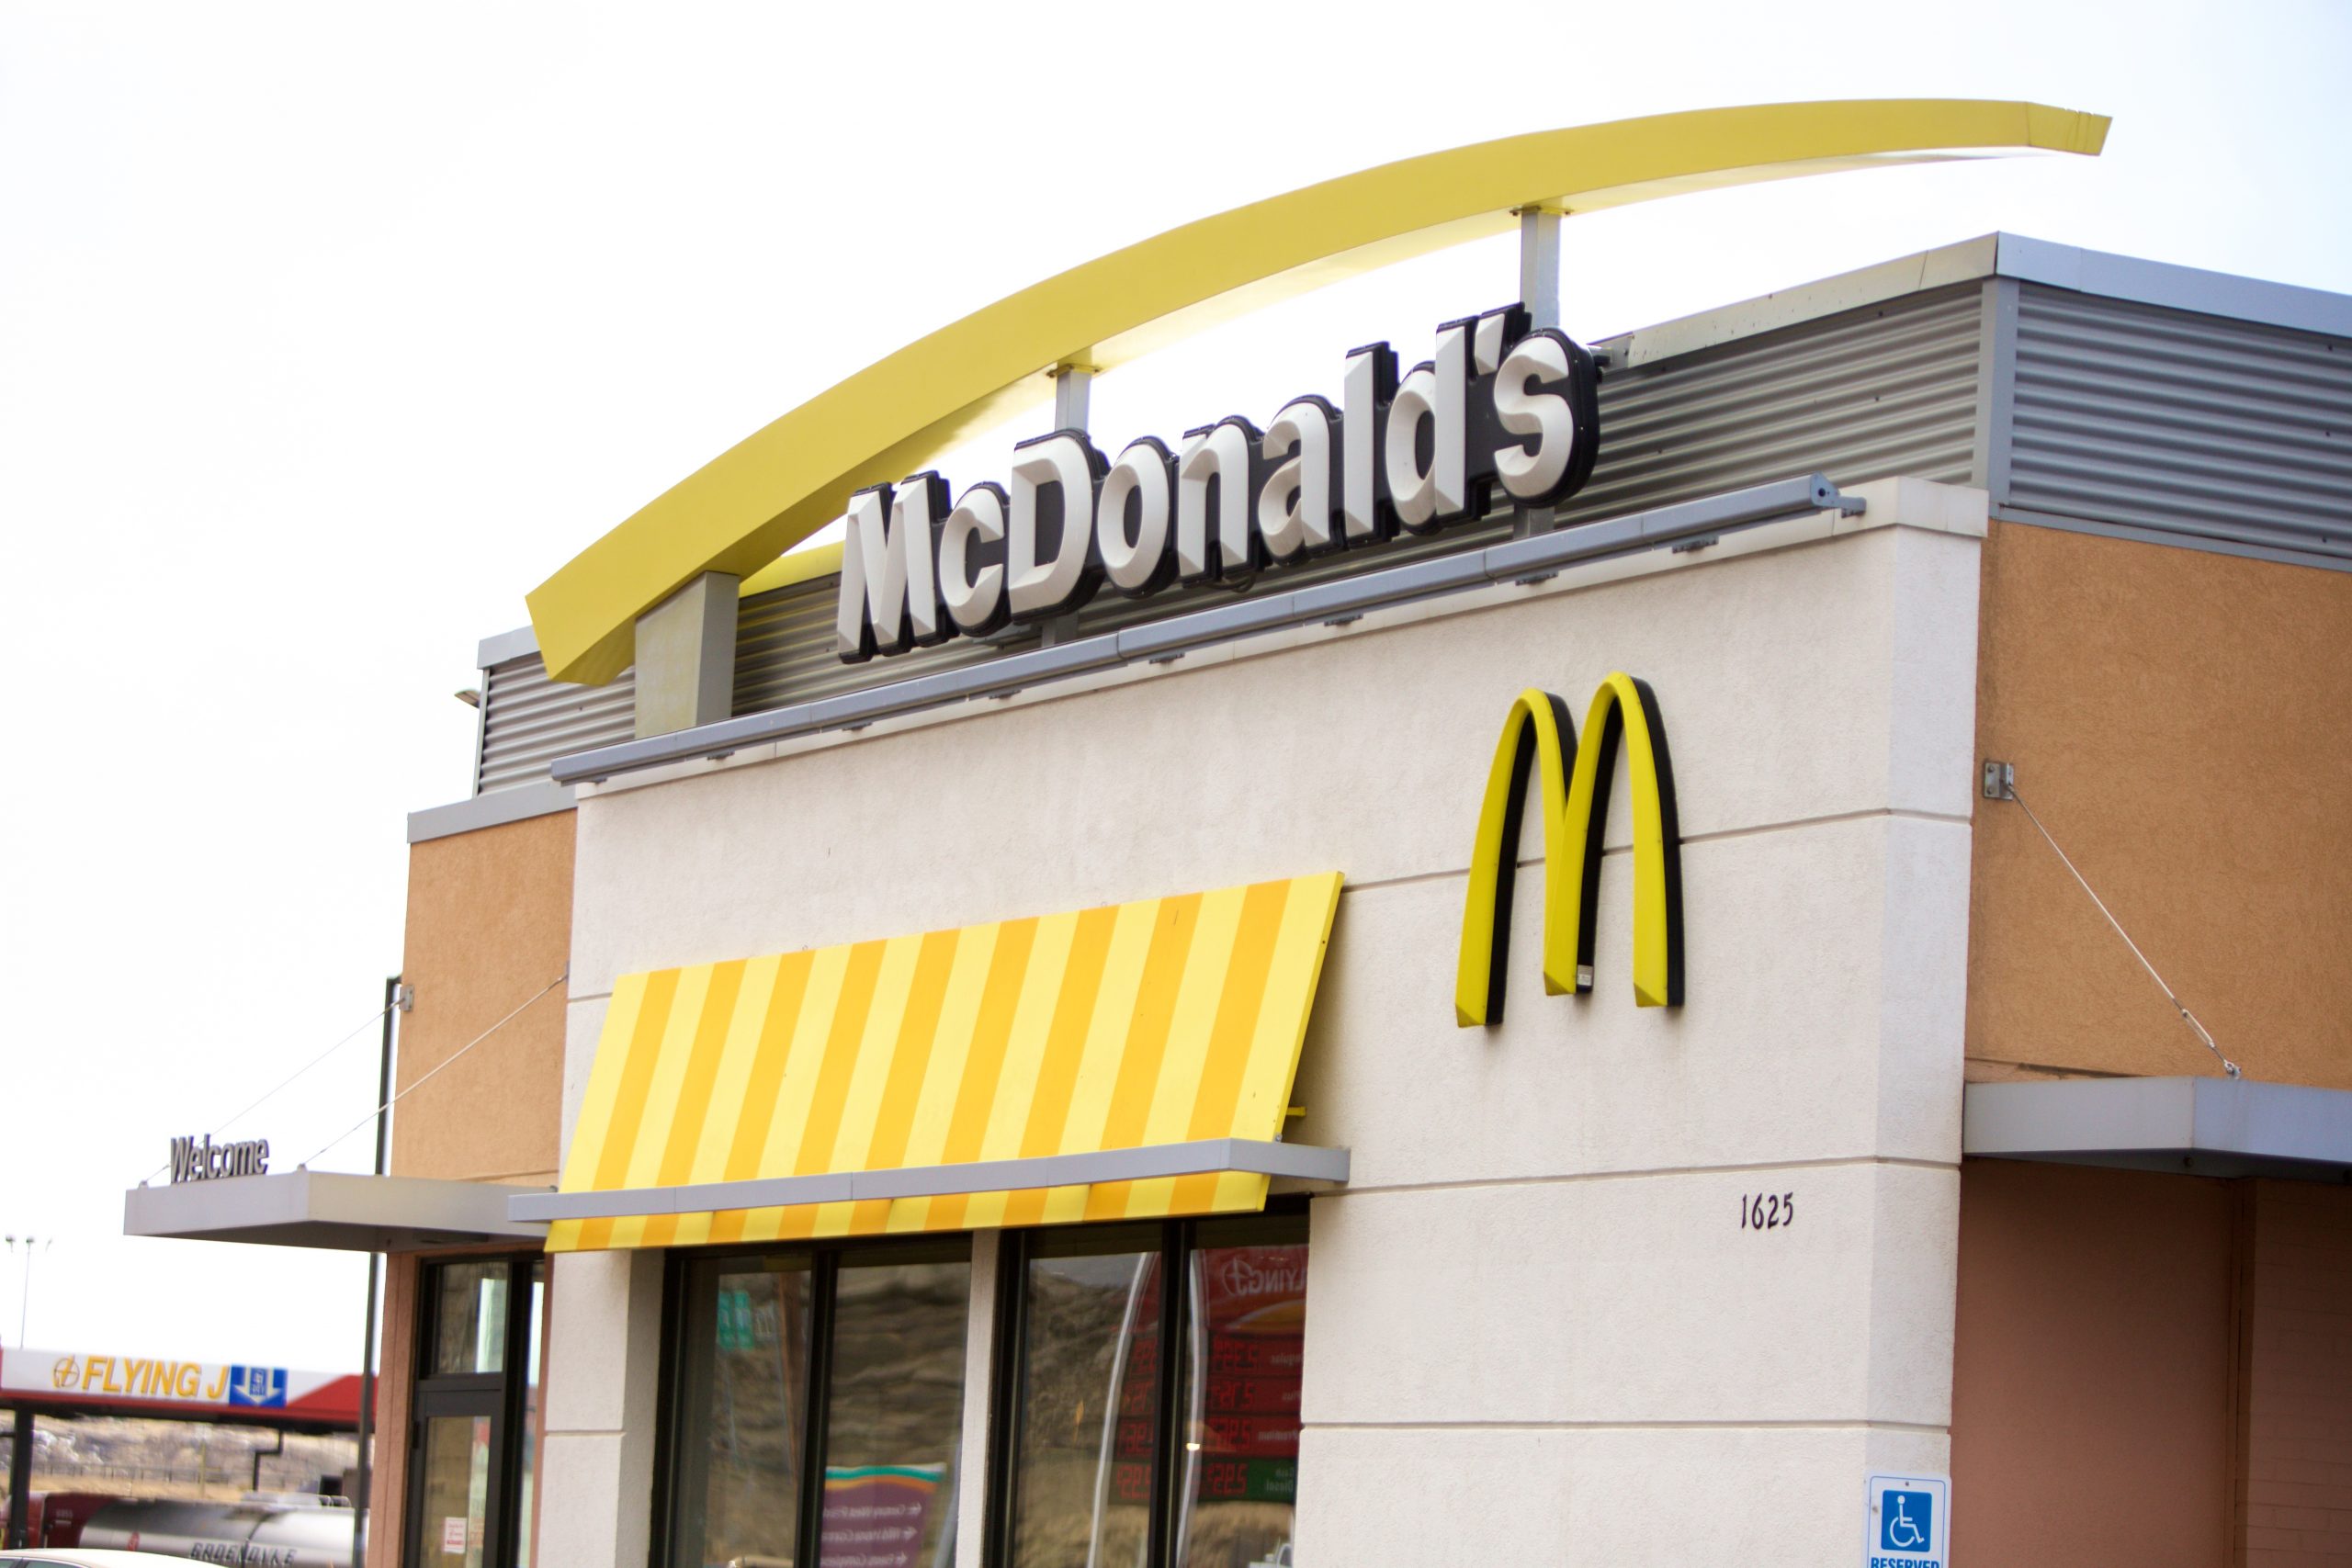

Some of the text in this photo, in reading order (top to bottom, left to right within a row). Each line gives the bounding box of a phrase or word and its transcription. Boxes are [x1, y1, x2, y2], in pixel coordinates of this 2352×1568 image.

[837, 304, 1599, 663] McDonald's
[170, 1134, 269, 1183] Welcome
[1741, 1191, 1793, 1230] 1625
[82, 1356, 202, 1399] FLYING
[206, 1365, 230, 1401] J
